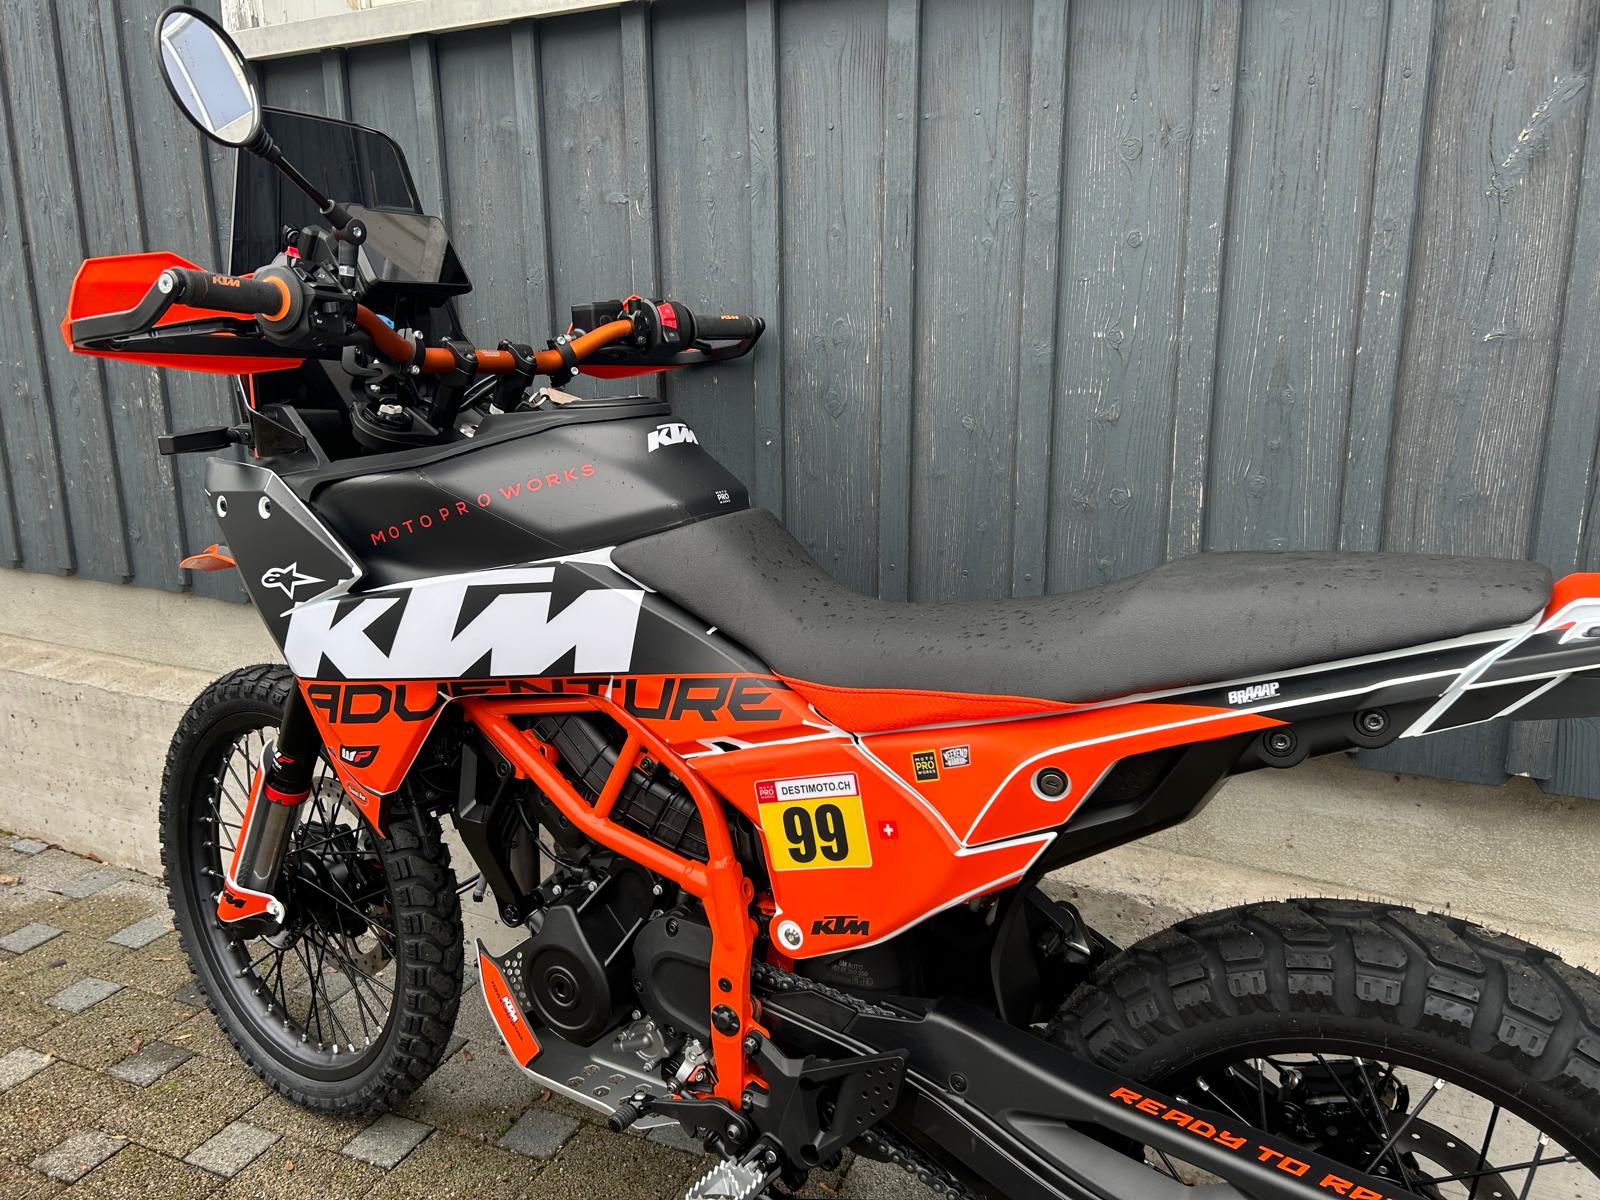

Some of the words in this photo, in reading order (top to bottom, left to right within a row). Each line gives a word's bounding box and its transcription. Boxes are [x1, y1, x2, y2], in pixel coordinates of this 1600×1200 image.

[212, 275, 241, 288] KTM
[647, 422, 699, 453] KTM
[283, 566, 646, 679] KTM
[341, 748, 373, 763] WP
[915, 761, 935, 770] PRO
[781, 780, 851, 795] DESTIMOTO.CH
[782, 803, 849, 863] 99
[811, 915, 870, 936] KTM
[1109, 1086, 1248, 1151] READY
[1258, 1145, 1311, 1177] TO
[1319, 1173, 1394, 1200] RA
